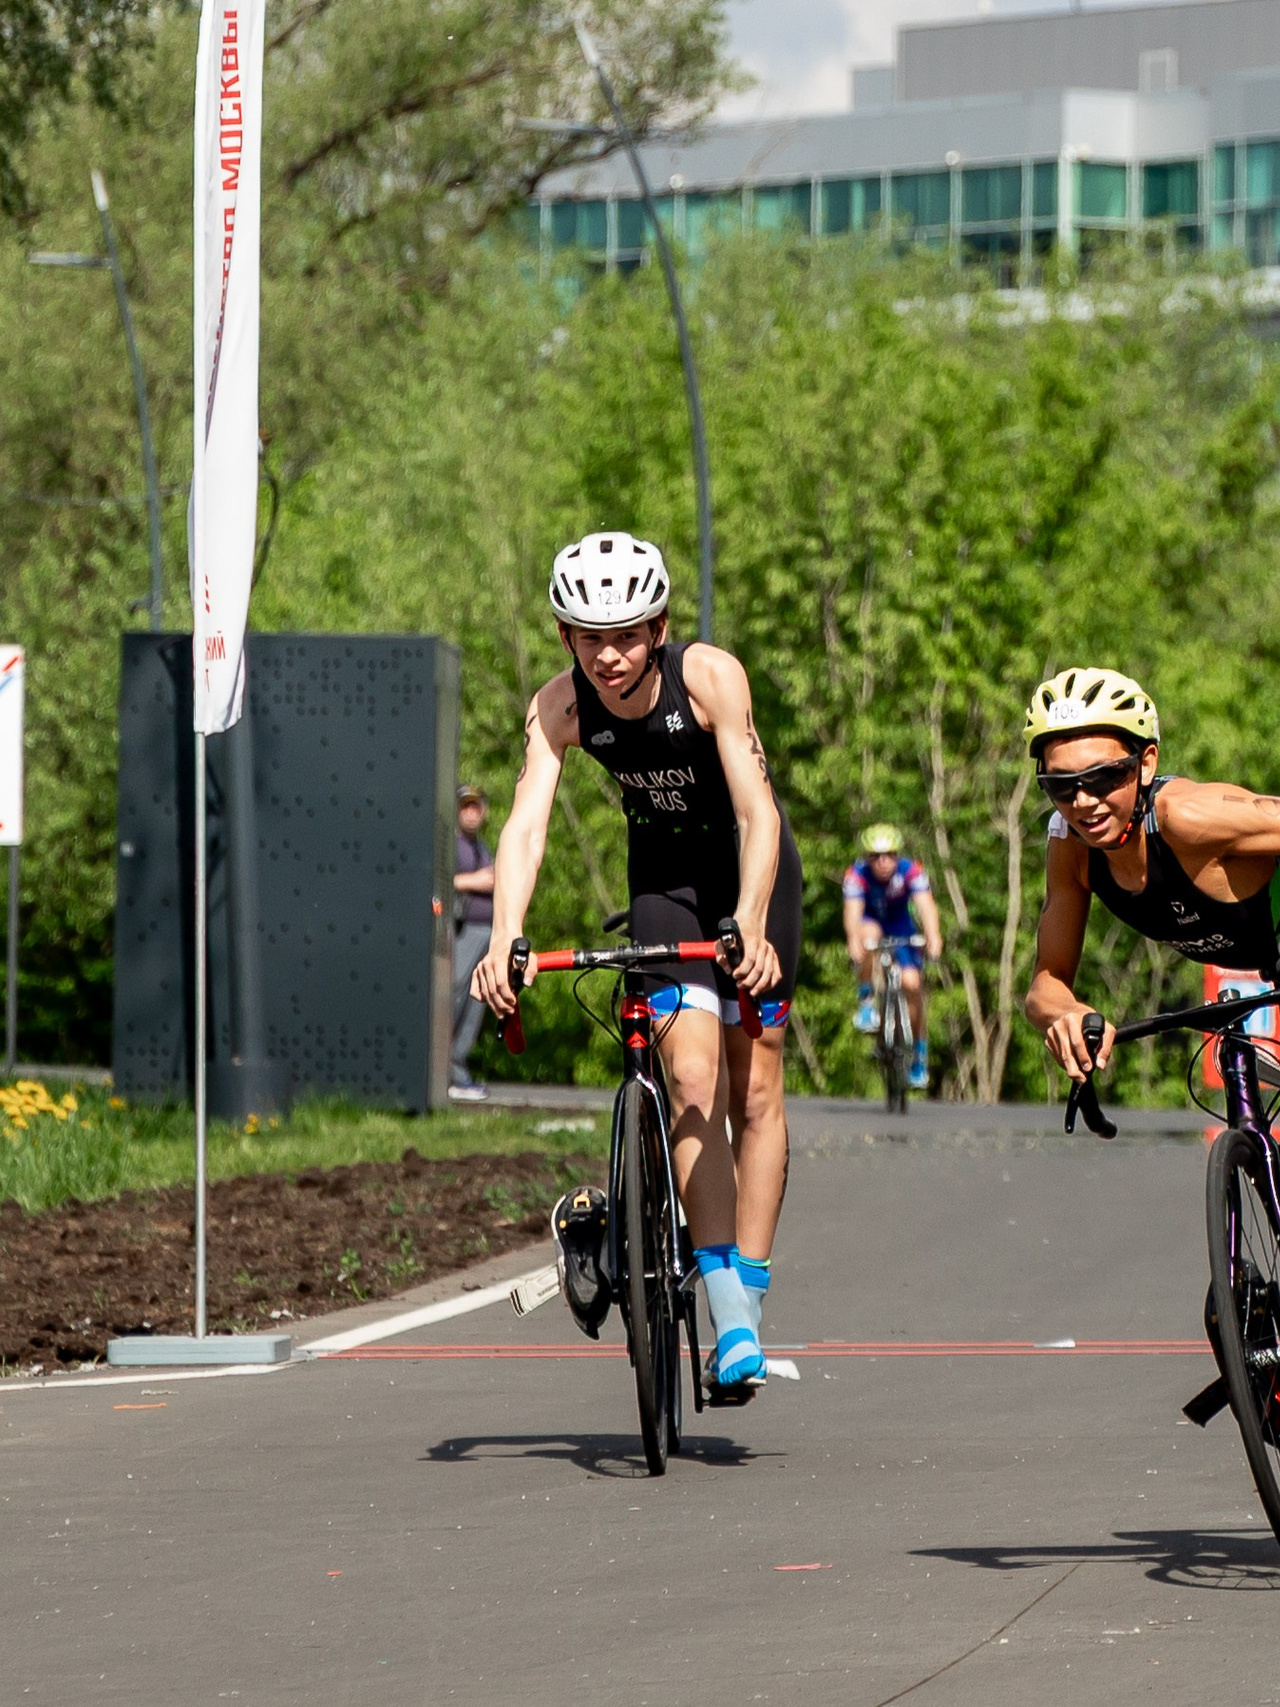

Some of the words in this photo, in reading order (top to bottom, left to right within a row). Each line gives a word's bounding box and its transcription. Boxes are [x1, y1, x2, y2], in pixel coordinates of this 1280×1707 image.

[219, 10, 243, 191] МОСКВЫ
[613, 765, 695, 788] KULIKOV
[649, 790, 687, 811] RUS
